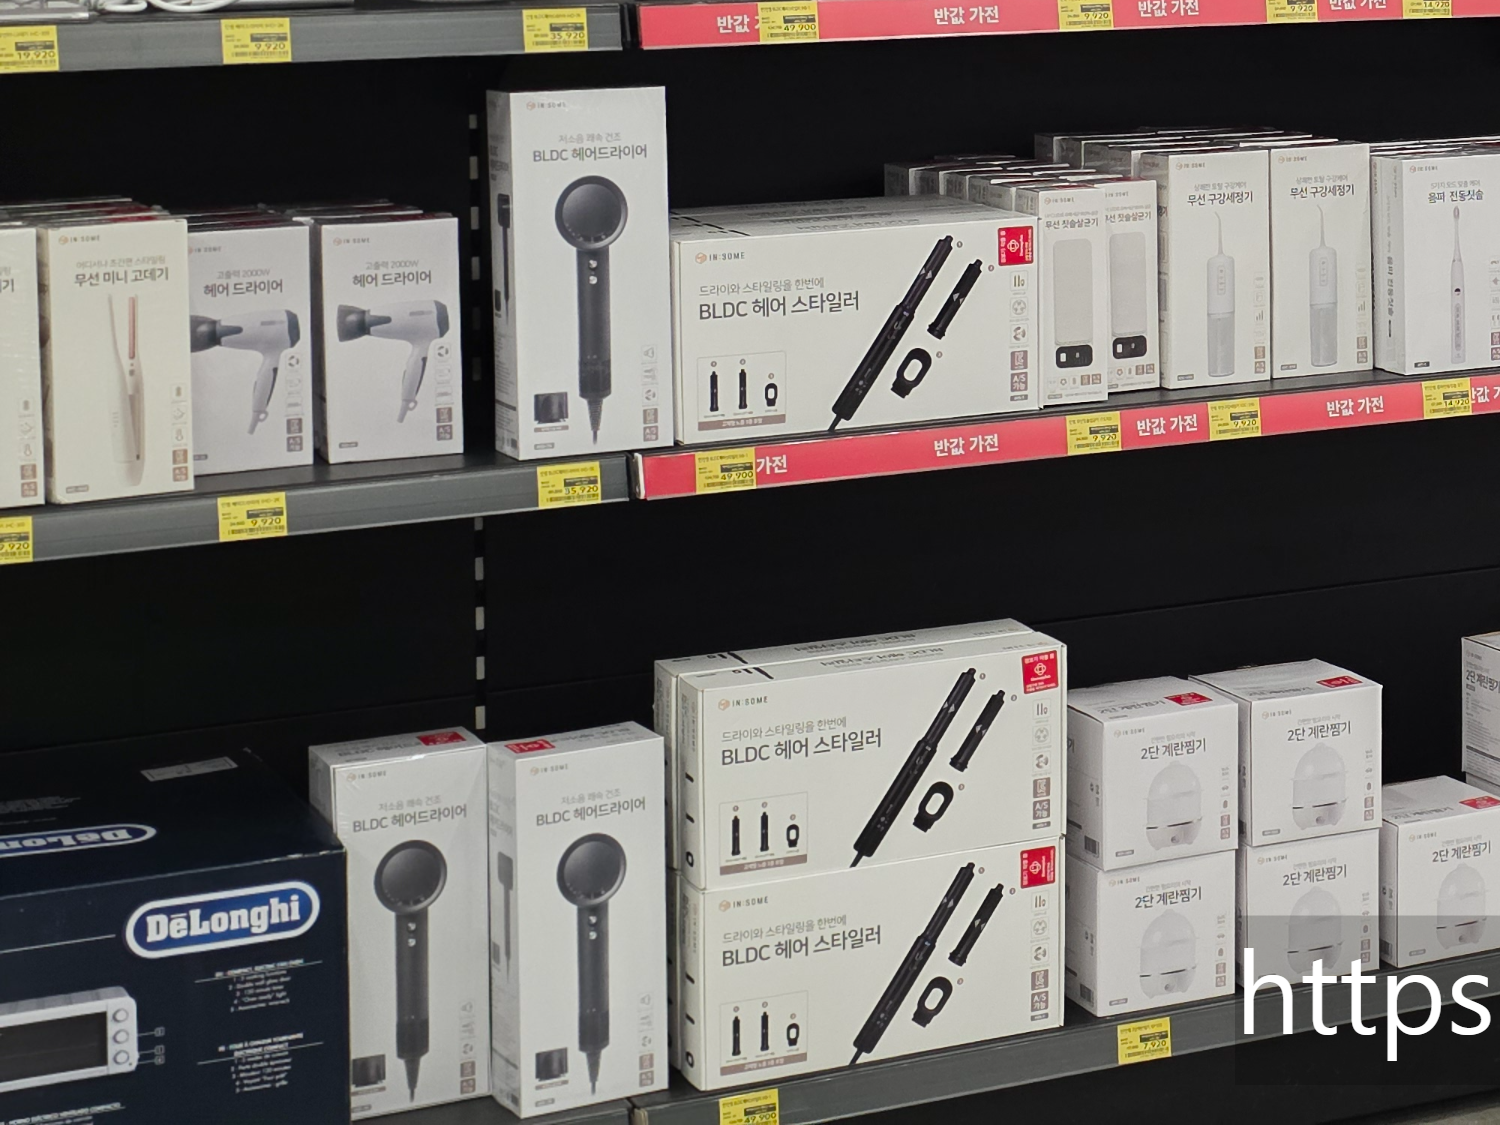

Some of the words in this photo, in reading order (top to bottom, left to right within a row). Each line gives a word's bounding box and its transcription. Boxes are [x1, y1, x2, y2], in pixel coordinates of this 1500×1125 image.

[717, 15, 749, 34] 반값
[934, 7, 965, 25] 반값
[969, 5, 999, 24] 가전
[1084, 12, 1109, 21] 9,920
[550, 32, 585, 41] 35,920
[783, 22, 816, 33] 49,900
[17, 50, 55, 60] 19,920
[255, 42, 286, 51] 9,920
[533, 149, 569, 163] BLDC
[571, 143, 648, 161] 헤어드라이어
[1187, 194, 1208, 206] 무선
[1209, 191, 1254, 205] 구강세정기
[1045, 220, 1060, 230] 무선
[1062, 216, 1099, 229] 칫솔살균기
[74, 272, 100, 287] 무선
[103, 270, 128, 285] 미니
[132, 267, 169, 283] 고데기
[352, 271, 378, 288] 헤어
[380, 269, 432, 286] 드라이어
[699, 283, 741, 296] 드라이와
[742, 279, 792, 294] 스타일링을
[794, 277, 824, 290] 한번에
[203, 281, 230, 297] 헤어
[233, 279, 283, 295] 드라이어
[699, 301, 748, 320] BLDC
[752, 295, 787, 318] 헤어
[791, 290, 859, 315] 스타일러
[1326, 399, 1353, 417] 반값
[1357, 396, 1384, 414] 가전
[1137, 417, 1165, 436] 반값
[1170, 414, 1198, 433] 가전
[934, 437, 965, 457] 반값
[969, 434, 999, 454] 가전
[1092, 434, 1117, 442] 9,920
[756, 455, 787, 474] 가전
[720, 471, 754, 482] 49,900
[251, 517, 282, 528] 9,920
[722, 745, 770, 765] BLDC
[774, 738, 809, 760] 헤어
[813, 728, 881, 754] 스타일러
[1141, 745, 1160, 760] 2단
[1162, 738, 1206, 757] 계란찜기
[353, 818, 388, 833] BLDC
[391, 803, 467, 827] 헤어드라이어
[722, 945, 771, 967] BLDC
[774, 937, 809, 959] 헤어
[813, 925, 881, 953] 스타일러
[744, 1112, 776, 1124] 49,900
